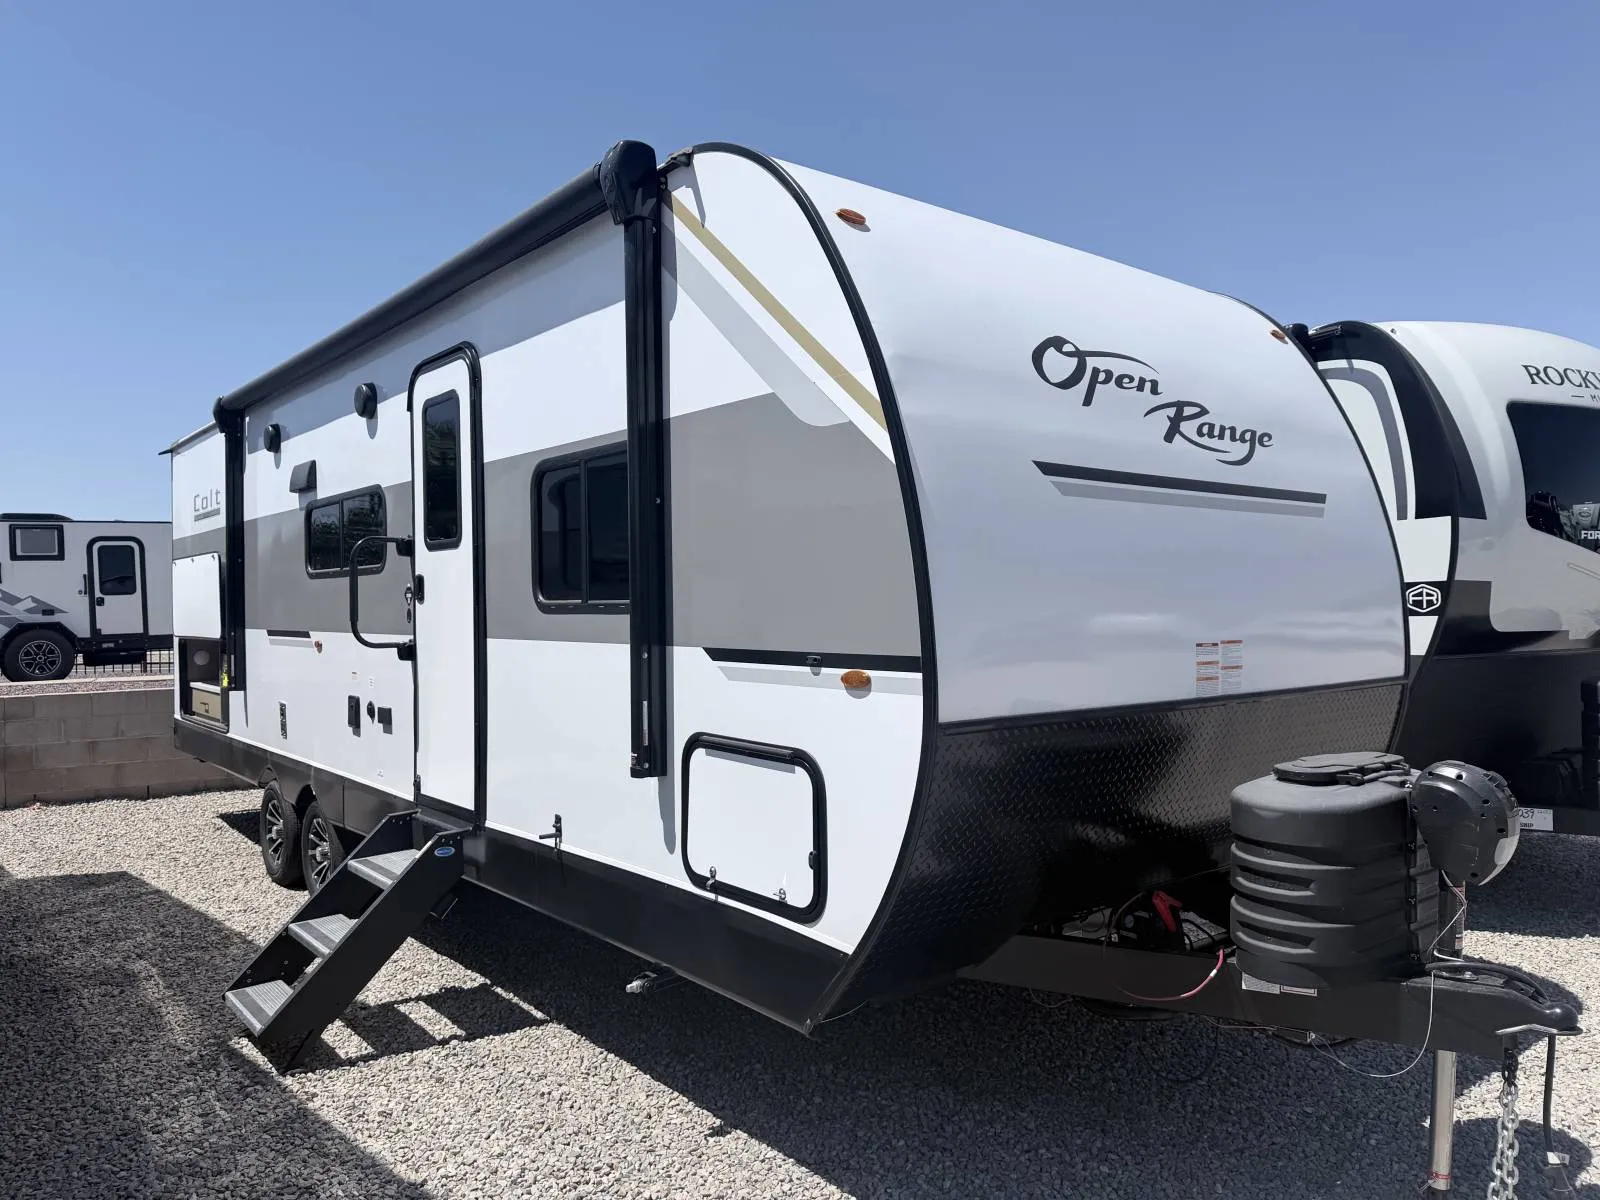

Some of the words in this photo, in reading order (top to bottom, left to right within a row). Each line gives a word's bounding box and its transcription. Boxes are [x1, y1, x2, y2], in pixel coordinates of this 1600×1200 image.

[1031, 335, 1163, 407] Open
[1143, 400, 1273, 466] Range
[193, 488, 221, 512] Colt
[1581, 530, 1600, 540] FOR
